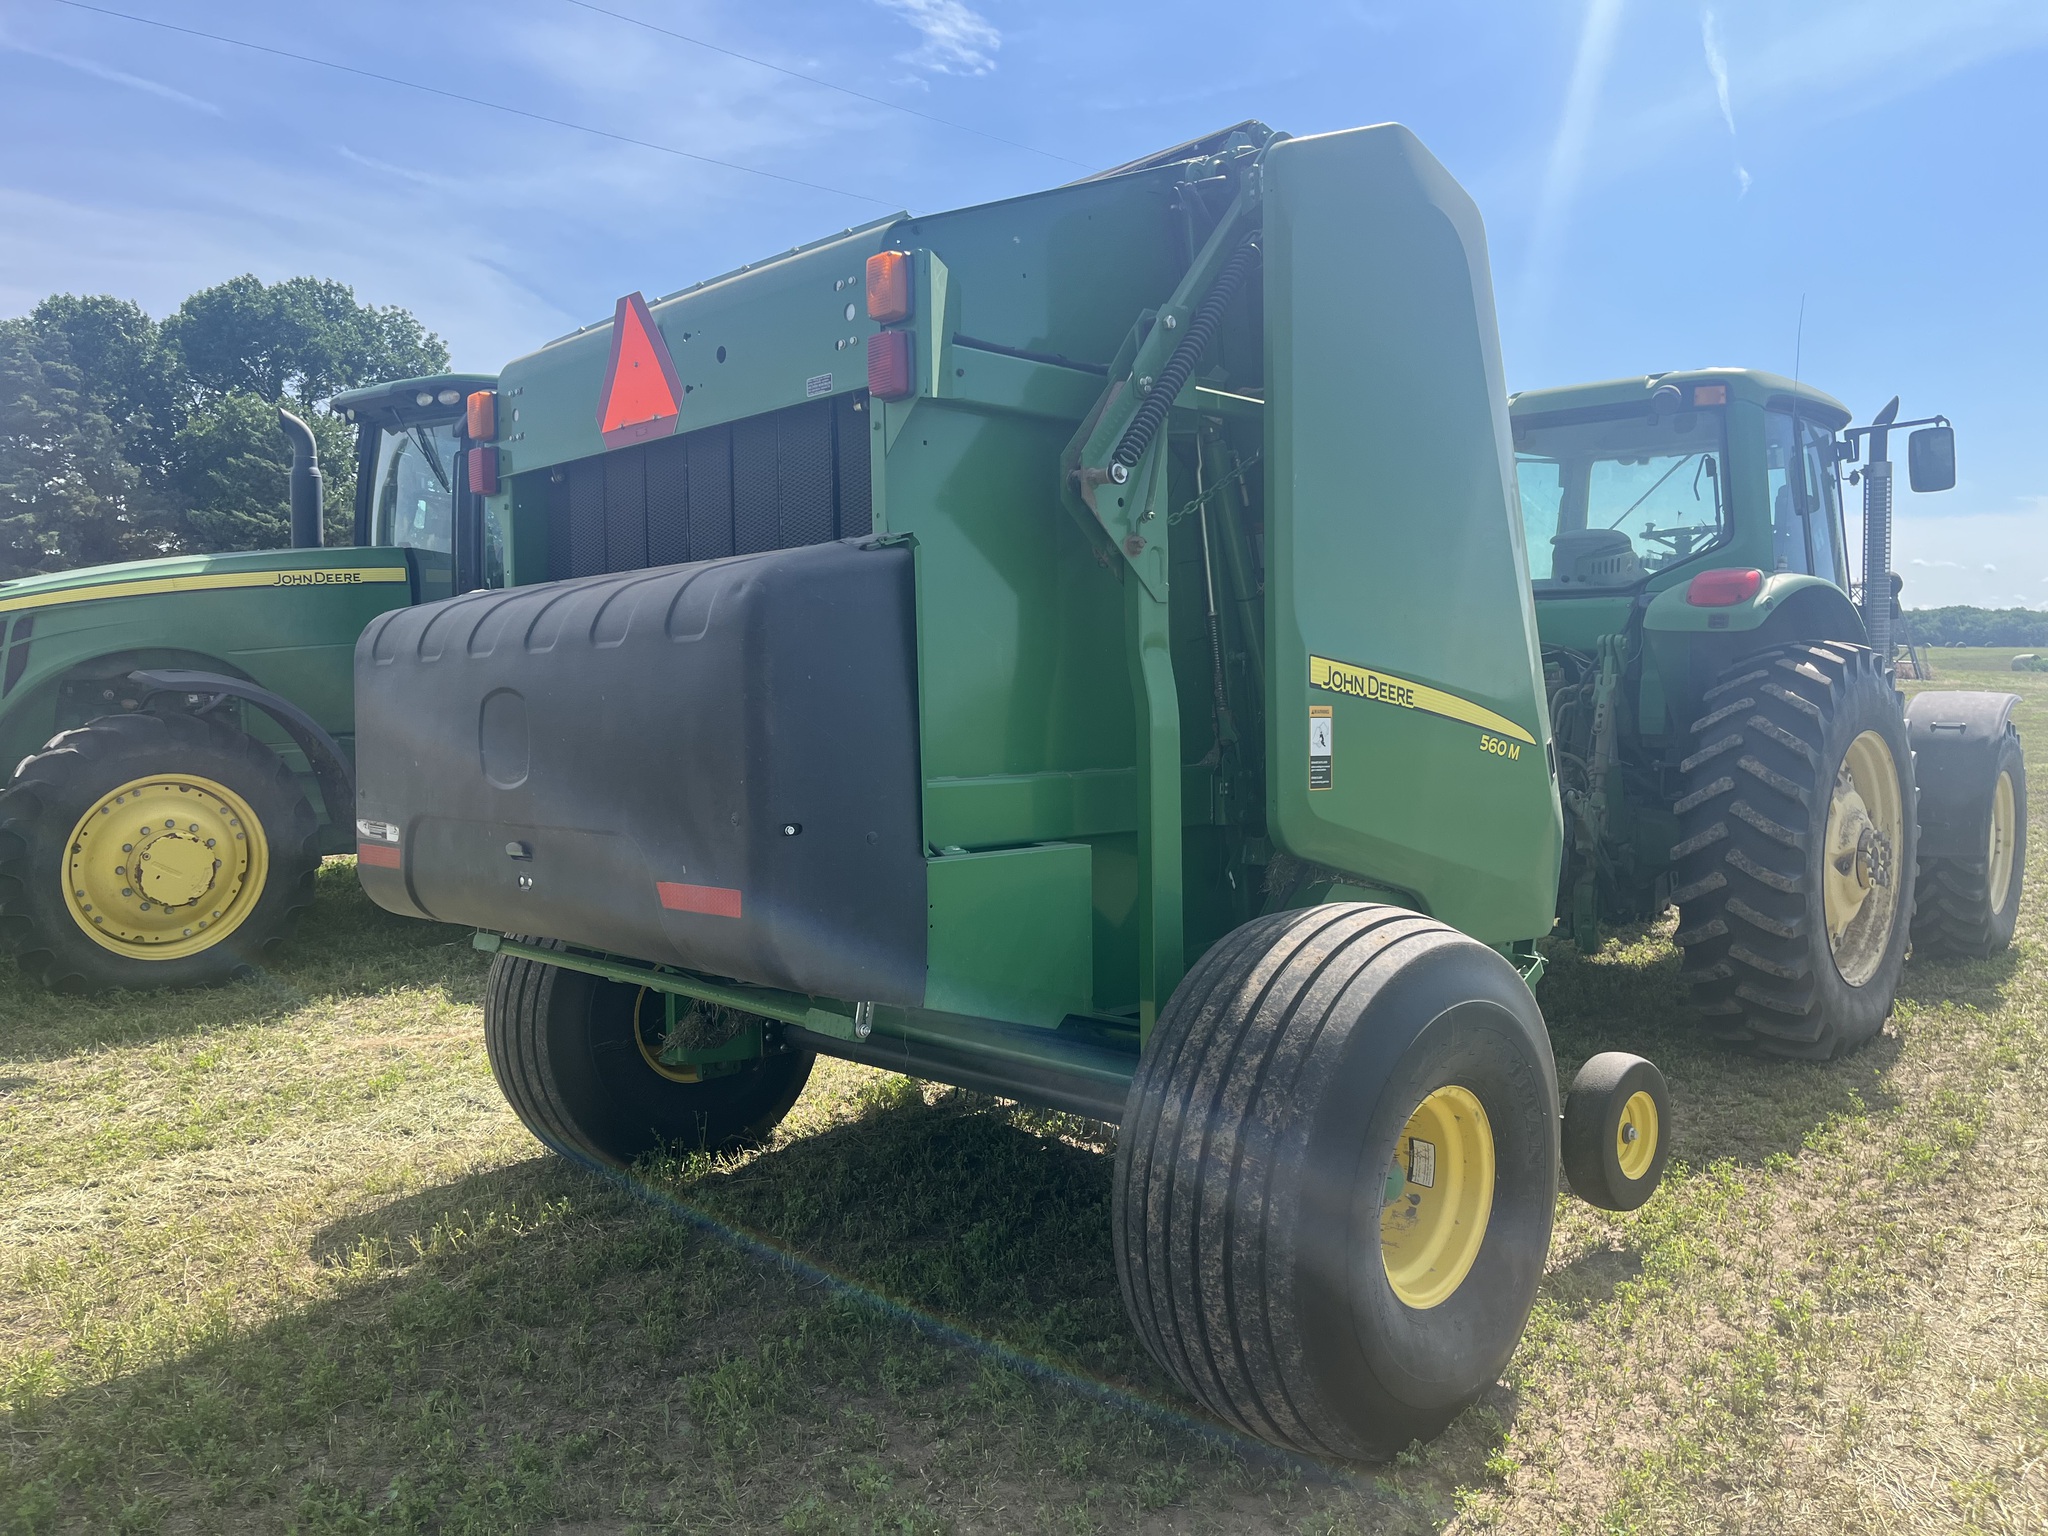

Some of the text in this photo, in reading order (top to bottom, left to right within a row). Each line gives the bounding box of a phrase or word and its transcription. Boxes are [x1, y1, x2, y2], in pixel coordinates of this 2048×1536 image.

[273, 572, 361, 585] JOHN DEERE
[1323, 665, 1414, 706] JOHN DEERE
[1479, 734, 1521, 760] 560 M
